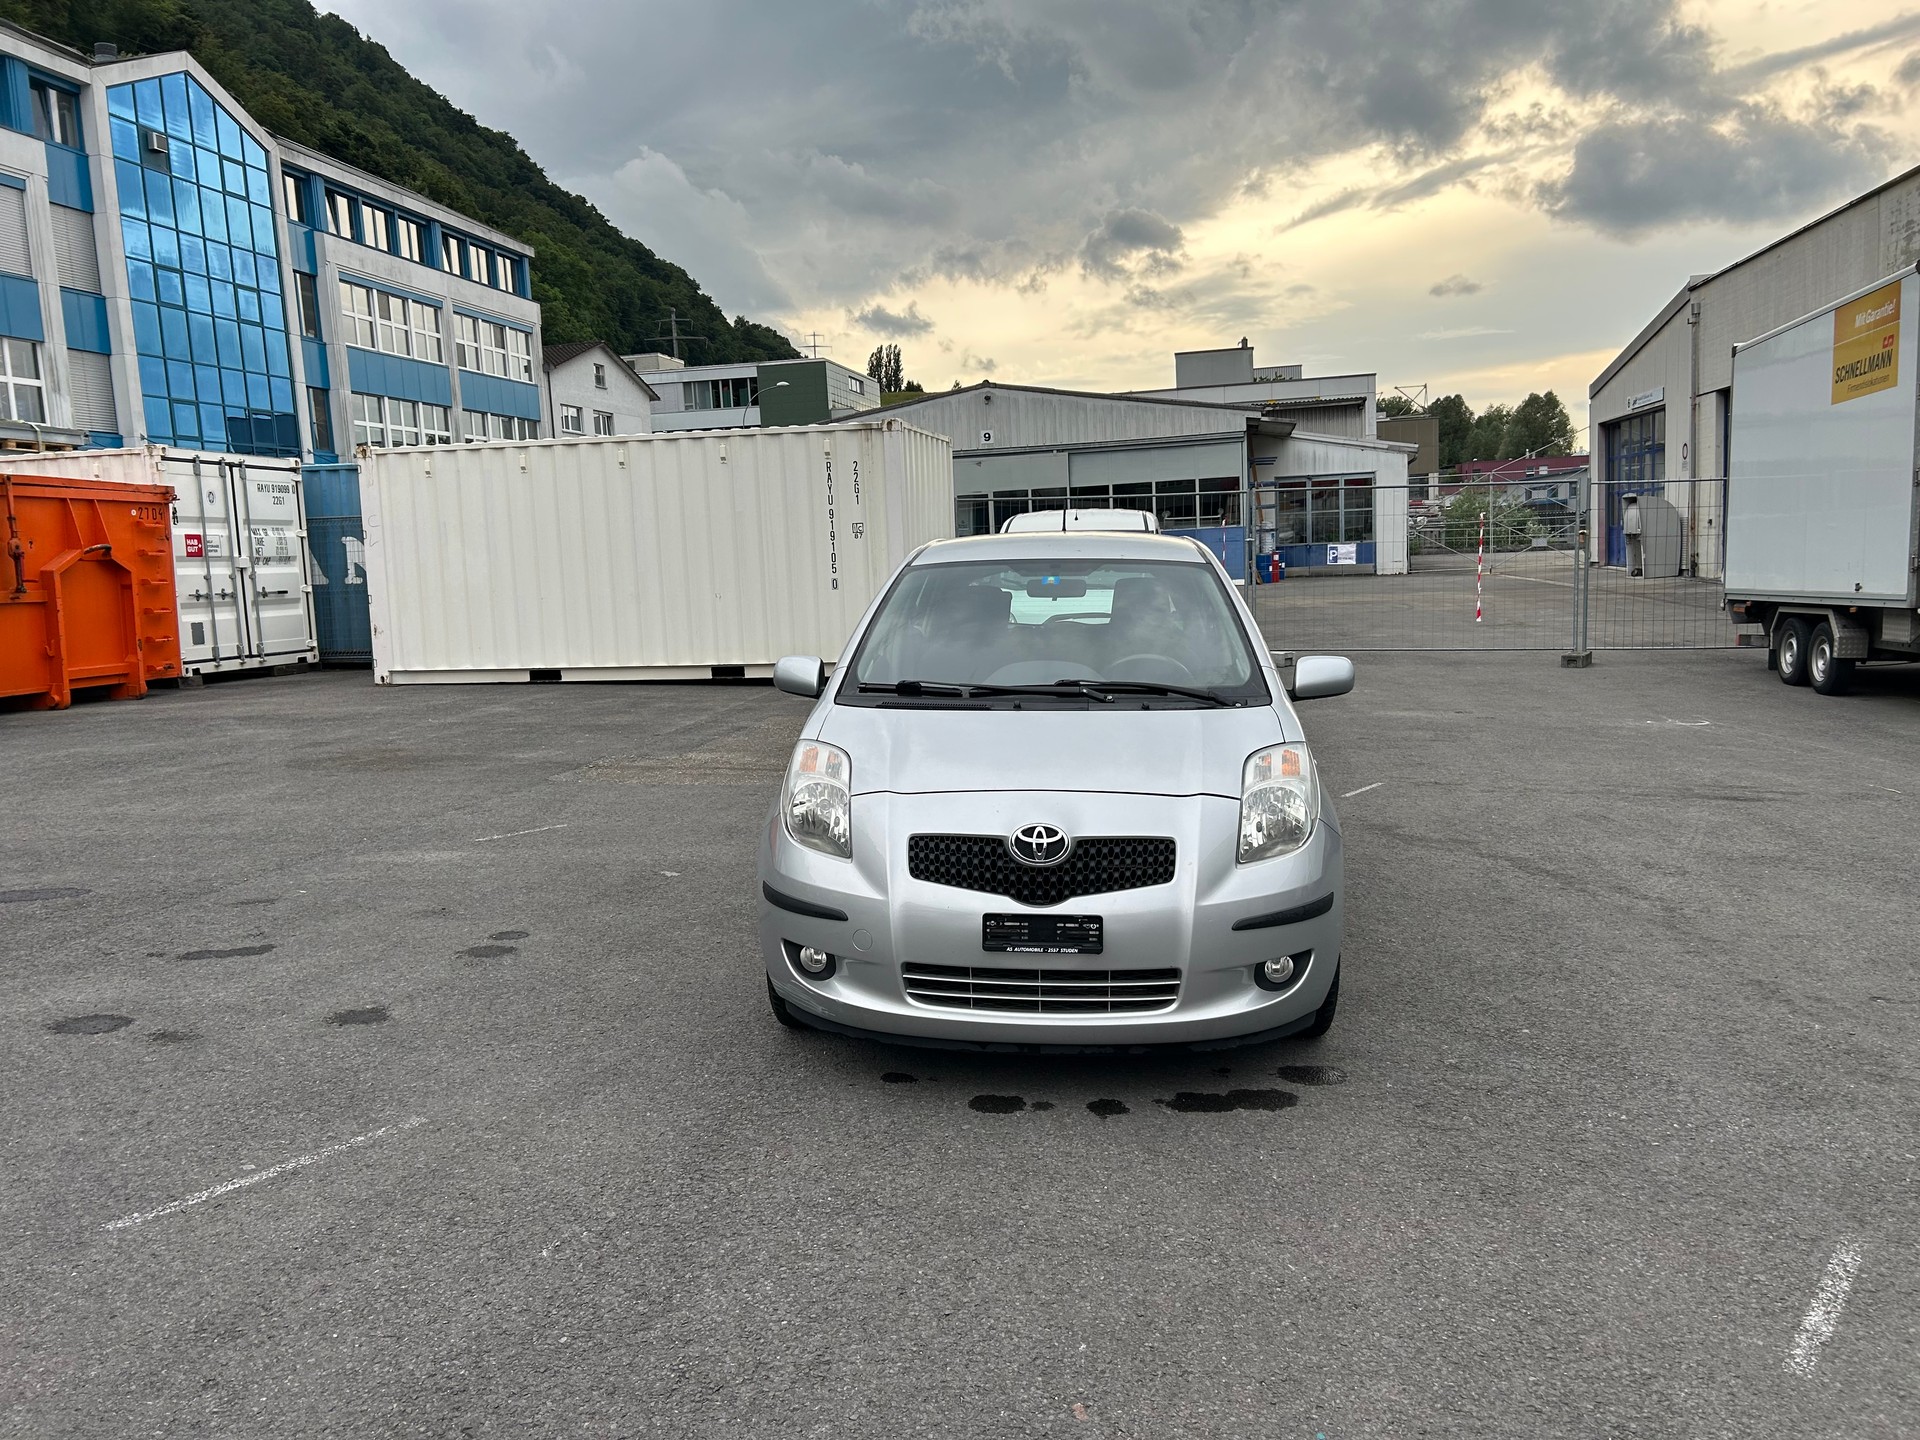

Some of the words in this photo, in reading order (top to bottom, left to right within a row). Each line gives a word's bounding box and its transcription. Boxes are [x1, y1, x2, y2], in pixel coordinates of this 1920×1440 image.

[1855, 309, 1866, 328] Mit
[1866, 299, 1896, 323] Garantie!
[1835, 349, 1893, 384] SCHNELLMANN
[983, 432, 991, 442] 9
[256, 483, 270, 493] RAYU
[826, 461, 834, 505] RAYU
[828, 508, 837, 574] 919105
[832, 578, 838, 590] 0
